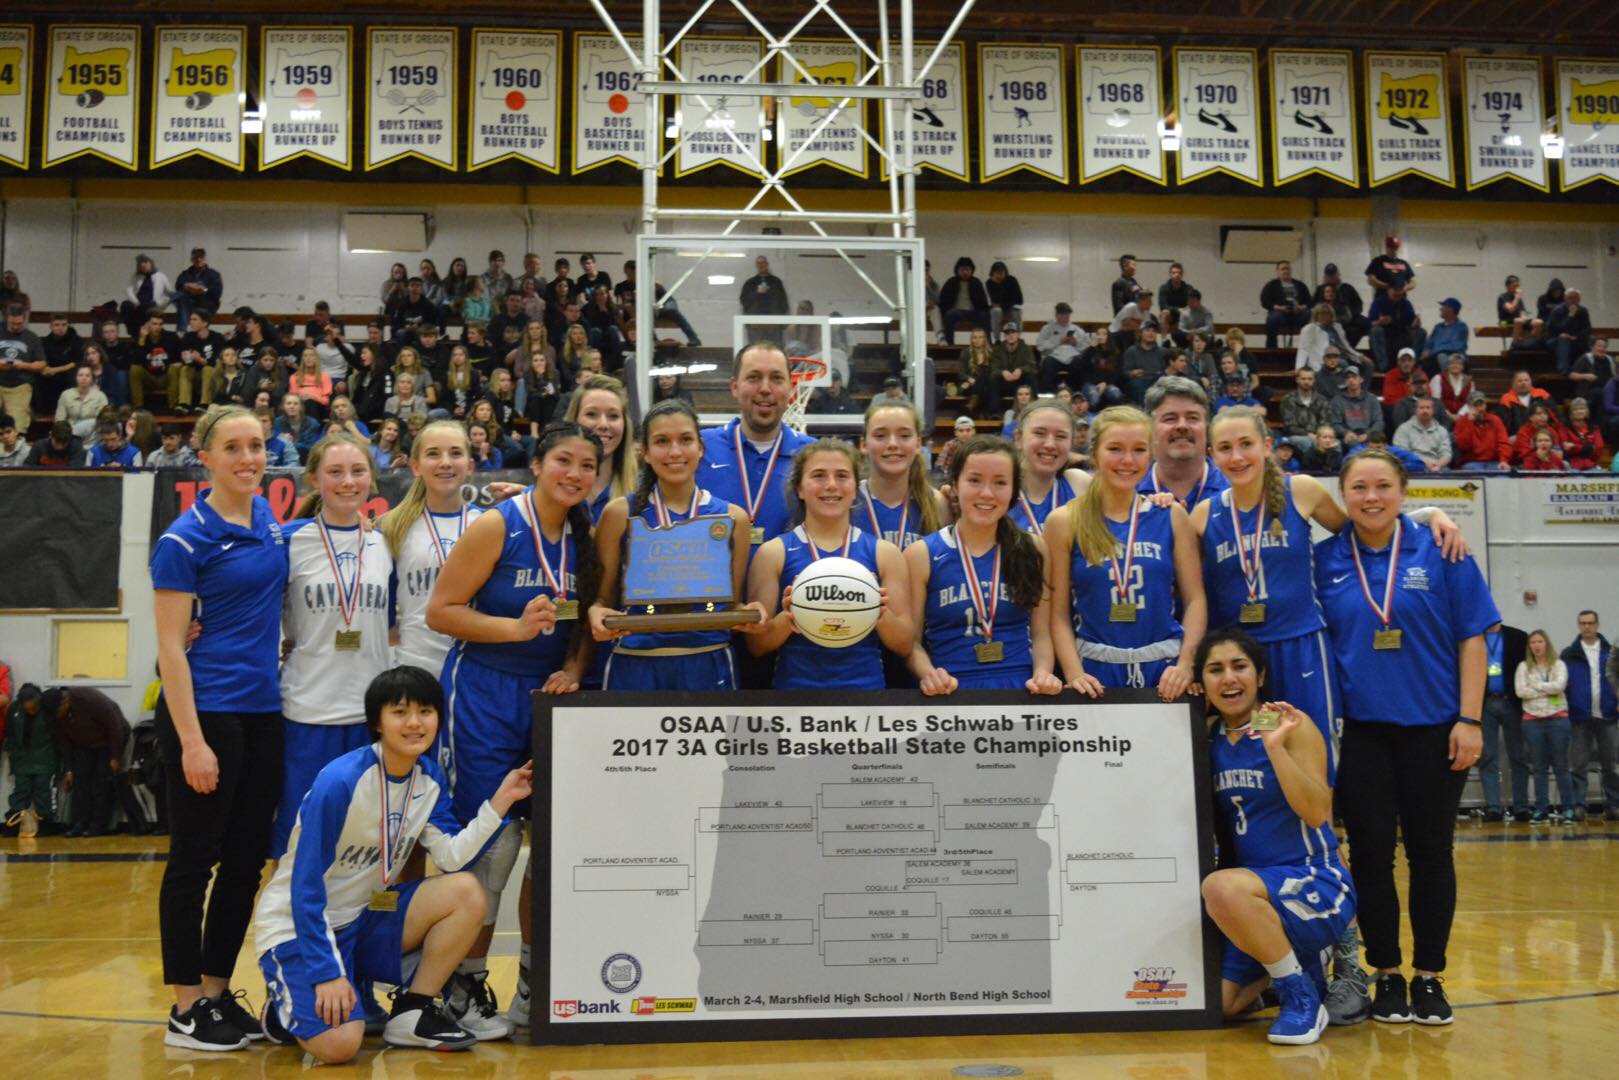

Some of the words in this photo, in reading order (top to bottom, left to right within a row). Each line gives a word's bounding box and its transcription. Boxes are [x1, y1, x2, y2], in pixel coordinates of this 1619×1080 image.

[68, 64, 122, 85] 1955
[175, 65, 229, 86] 1956
[283, 65, 333, 86] 1959
[388, 66, 438, 86] 1959
[493, 68, 542, 89] 1960
[1000, 81, 1047, 102] 1968
[1097, 84, 1144, 103] 1968
[1194, 84, 1238, 105] 1970
[1290, 86, 1330, 106] 1971
[1384, 88, 1429, 109] 1972
[1482, 91, 1523, 111] 1974
[63, 117, 119, 129] FOOTBALL
[170, 117, 226, 129] FOOTBALL
[500, 113, 529, 125] BOYS
[604, 117, 632, 128] BOYS
[272, 123, 340, 134] BASKETBALL
[379, 120, 403, 131] BOYS
[407, 120, 443, 131] TENNIS
[480, 125, 548, 137] BASKETBALL
[56, 130, 126, 143] CHAMPIONS
[163, 130, 232, 143] CHAMPIONS
[275, 134, 317, 146] RUNNER
[321, 135, 337, 145] UP
[382, 134, 424, 146] RUNNER
[428, 134, 443, 145] UP
[822, 128, 857, 140] TENNIS
[922, 131, 957, 143] TRACK
[992, 133, 1053, 146] WRESTLING
[483, 137, 526, 149] RUNNER
[530, 138, 545, 149] UP
[588, 140, 630, 152] RUNNER
[1185, 138, 1212, 148] GIRLS
[1215, 138, 1250, 149] TRACK
[1281, 136, 1310, 148] GIRLS
[1312, 137, 1346, 148] TRACK
[1377, 138, 1407, 149] GIRLS
[1409, 139, 1441, 149] TRACK
[691, 143, 733, 154] RUNNER
[938, 146, 954, 156] UP
[993, 148, 1035, 159] RUNNER
[1038, 148, 1053, 159] UP
[1092, 148, 1134, 159] RUNNER
[1137, 148, 1151, 159] UP
[1190, 151, 1229, 162] RUNNER
[1233, 152, 1247, 162] UP
[1286, 150, 1326, 161] RUNNER
[1329, 151, 1343, 161] UP
[1379, 151, 1441, 162] CHAMPIONS
[1479, 157, 1519, 169] RUNNER
[1522, 158, 1535, 169] UP
[805, 584, 867, 604] Wilson
[660, 716, 726, 734] OSAA
[747, 715, 791, 733] U.S.
[800, 715, 858, 732] Bank
[878, 714, 918, 732] Les
[925, 713, 1014, 732] Schwab
[1021, 713, 1078, 731] Tires
[612, 738, 669, 757] 2017
[676, 738, 707, 757] 3A
[714, 737, 769, 756] Girls
[777, 736, 898, 756] Basketball
[905, 735, 967, 755] State
[973, 734, 1133, 757] Championship
[728, 764, 776, 773] Consolation
[850, 763, 902, 772] Quarterfinals
[976, 763, 1017, 772] Semifinals
[1105, 761, 1124, 770] Final
[1070, 884, 1097, 892] DAYTON
[704, 994, 741, 1005] March
[743, 994, 767, 1007] 2-4,
[768, 992, 833, 1005] Marshfield
[834, 991, 861, 1006] High
[864, 990, 904, 1003] School
[912, 990, 948, 1002] North
[949, 989, 981, 1001] Bend
[982, 989, 1009, 1003] High
[1011, 988, 1051, 1001] School
